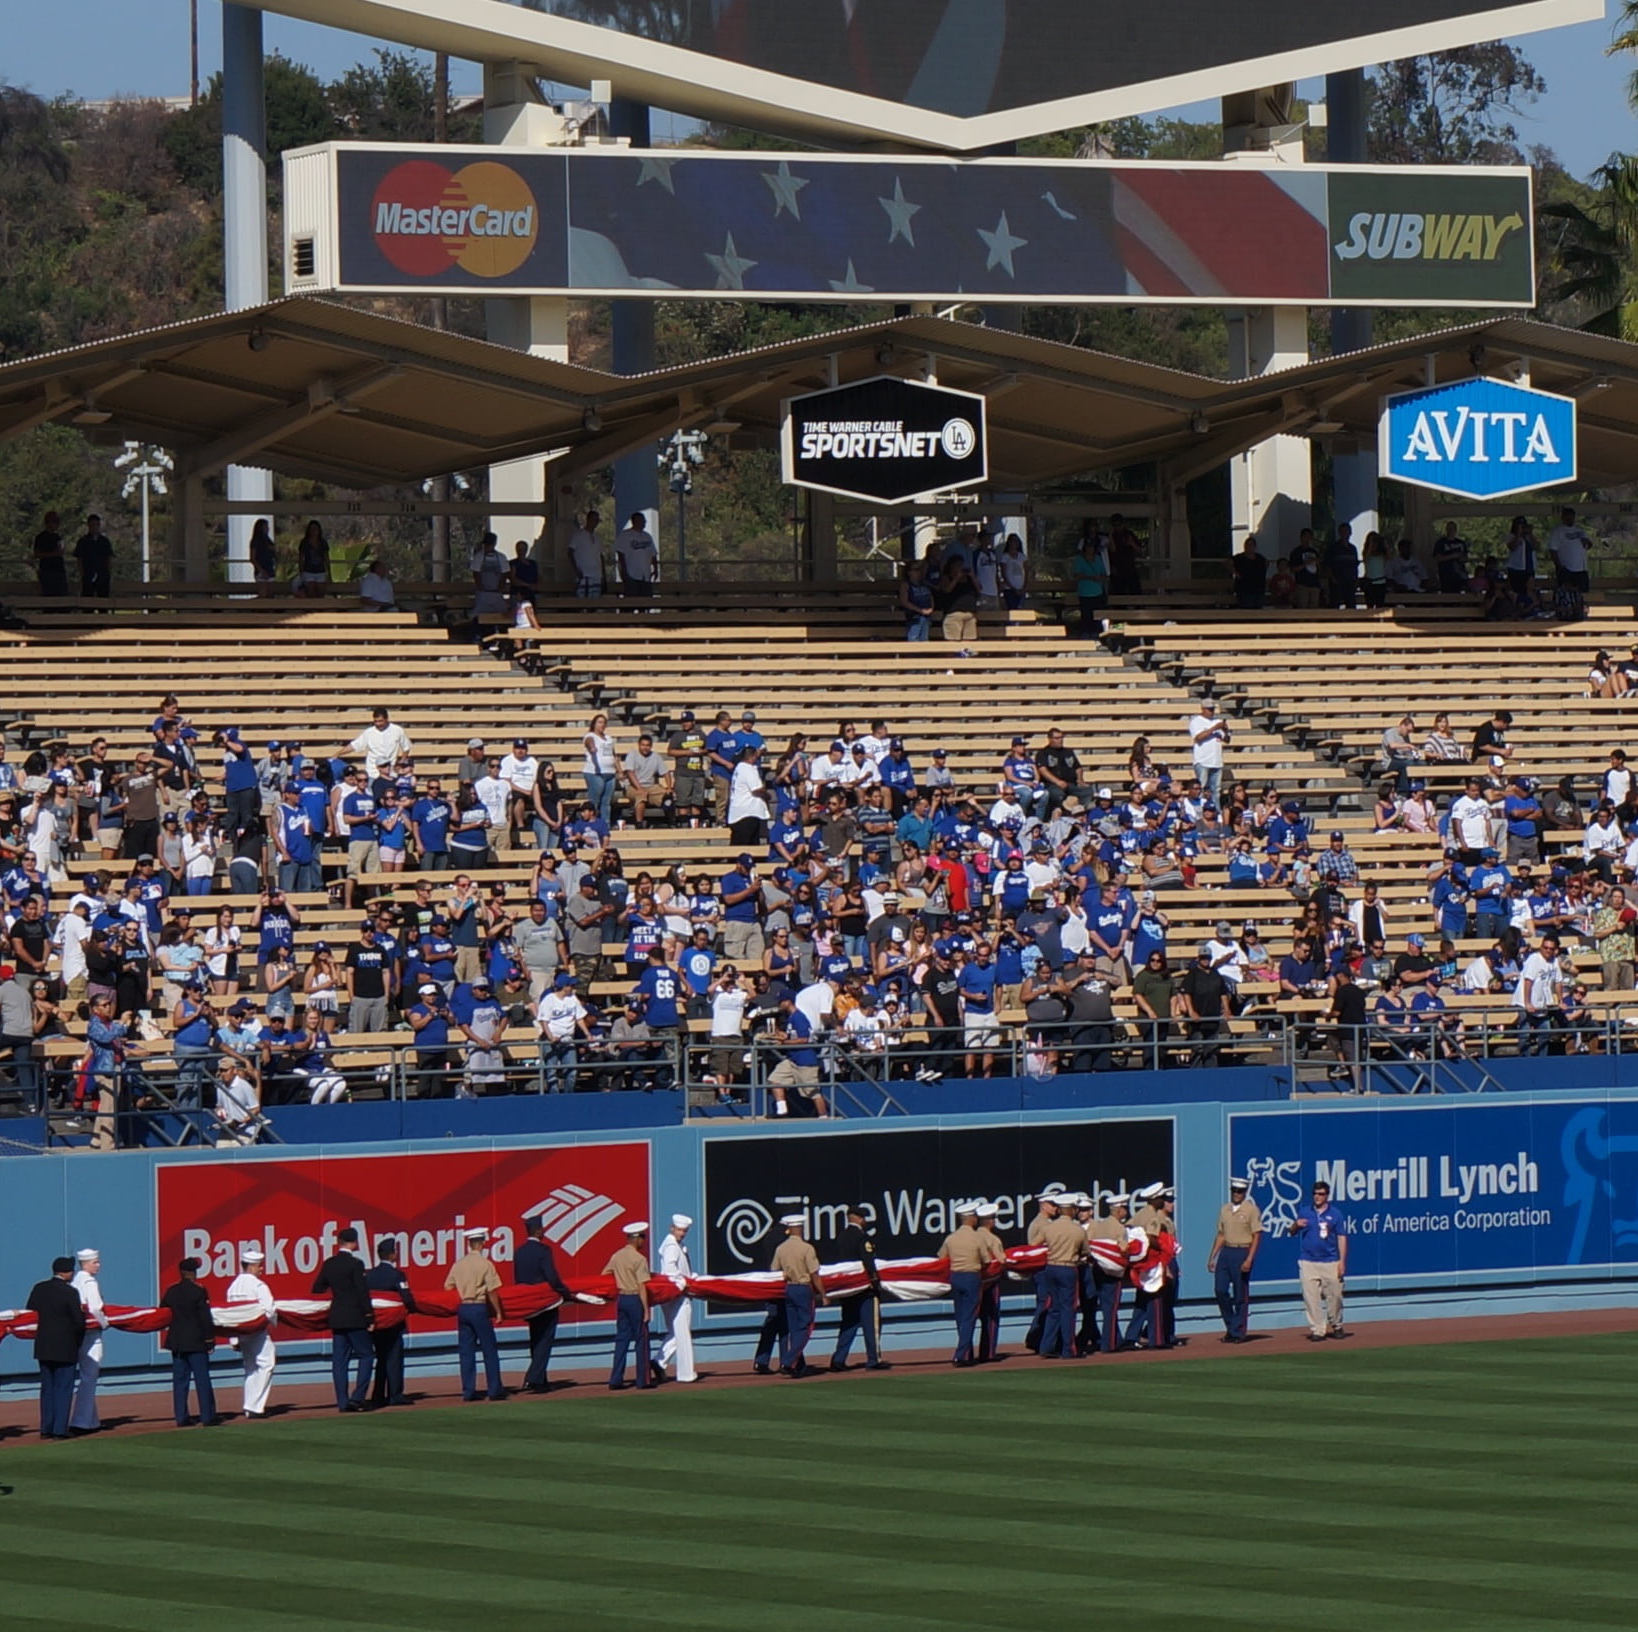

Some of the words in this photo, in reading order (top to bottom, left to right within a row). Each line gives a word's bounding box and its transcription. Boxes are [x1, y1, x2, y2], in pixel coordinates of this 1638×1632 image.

[375, 202, 533, 238] MasterCard
[1335, 211, 1523, 260] SUBWAY
[800, 431, 942, 459] SPORTSNET
[802, 421, 827, 433] TIME
[829, 421, 872, 433] WARNER
[873, 420, 903, 432] CABLE
[1402, 406, 1560, 463] AVITA
[1315, 1156, 1428, 1203] Merrill
[1440, 1151, 1538, 1205] Lynch
[883, 1188, 1032, 1236] Warer
[1362, 1214, 1378, 1233] of
[1383, 1211, 1450, 1233] America
[1454, 1206, 1551, 1232] Corporation
[293, 1220, 337, 1273] of
[350, 1215, 514, 1270] Ameria
